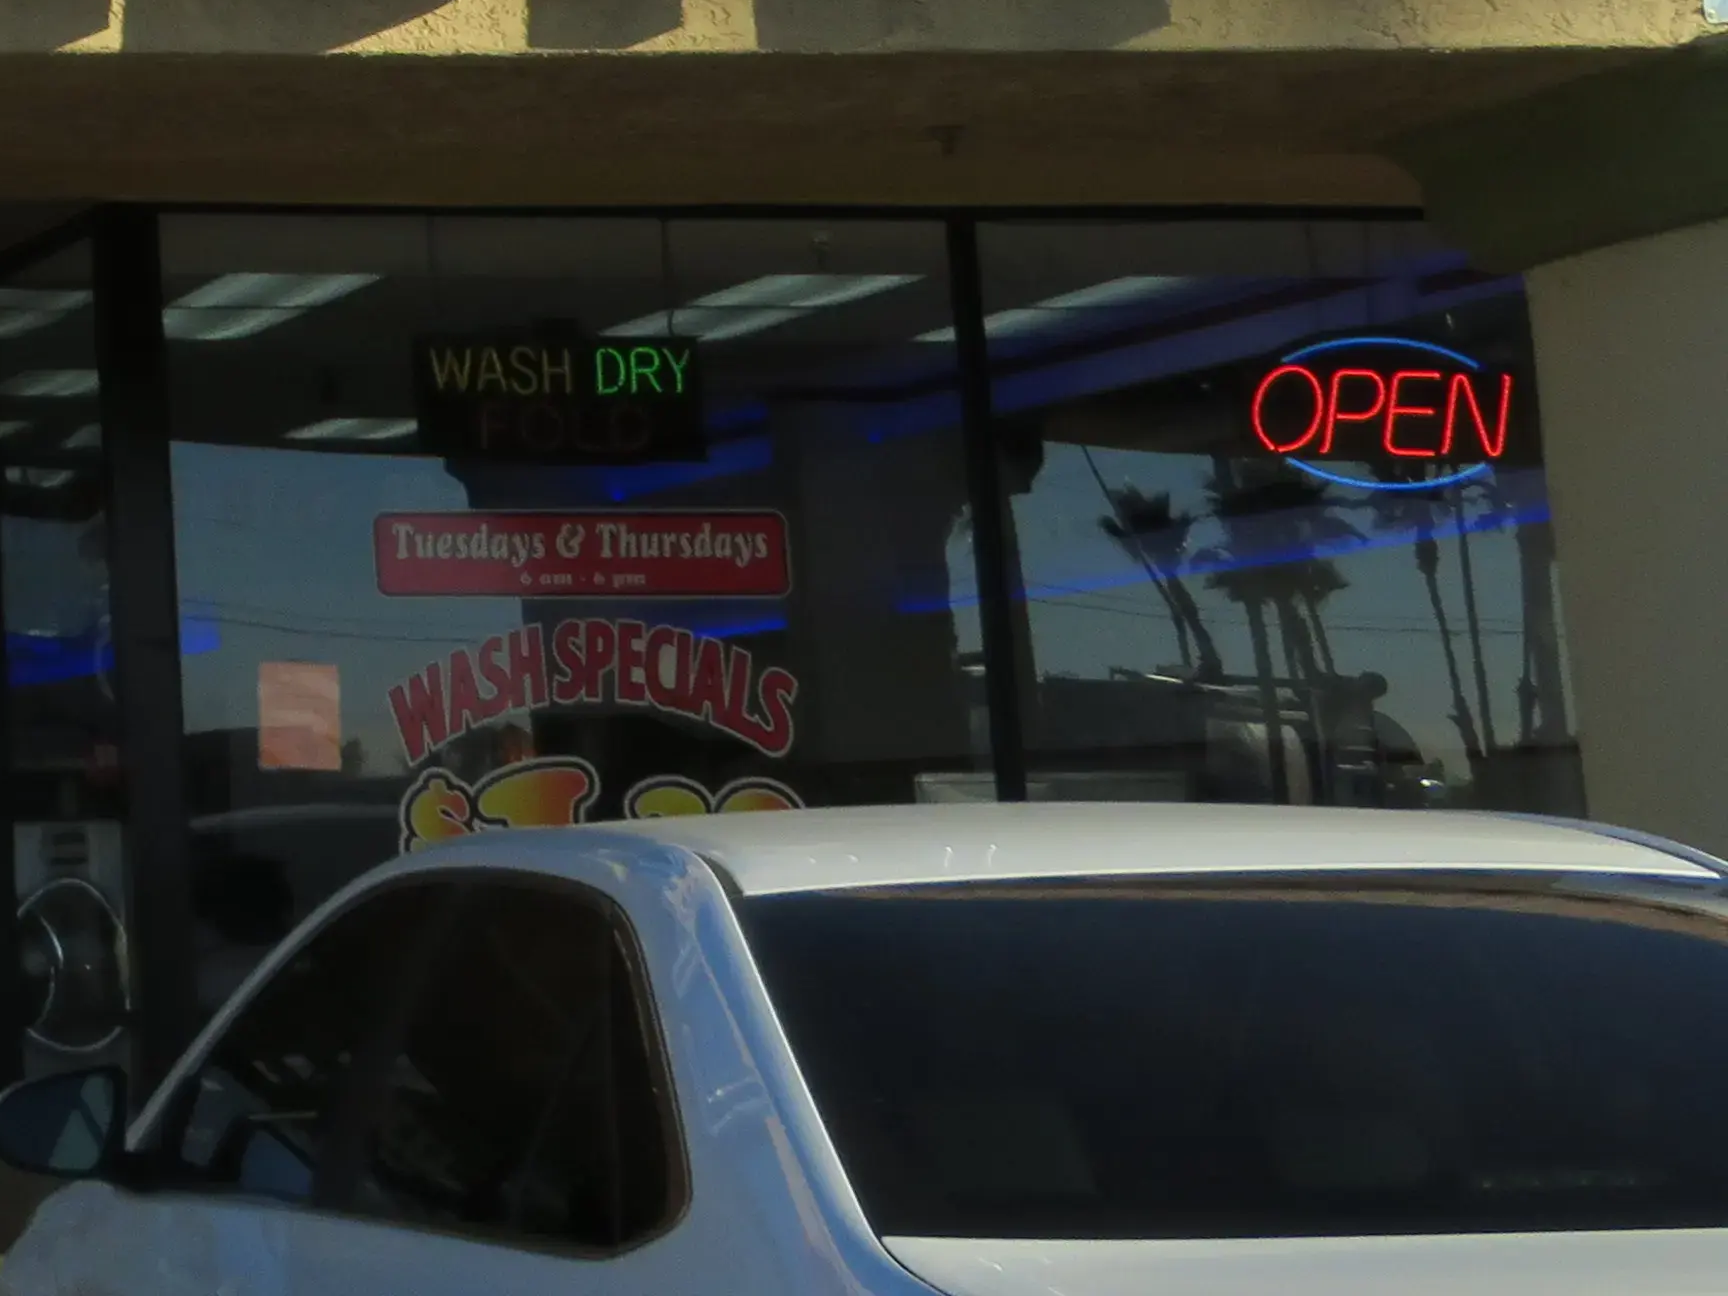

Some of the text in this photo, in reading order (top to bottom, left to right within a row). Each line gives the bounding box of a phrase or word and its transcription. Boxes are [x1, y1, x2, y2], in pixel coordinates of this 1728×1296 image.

[429, 345, 690, 395] WASH DRY
[1252, 364, 1513, 458] OPEN
[391, 521, 768, 568] Tuesdays & Thursdays
[388, 619, 799, 765] WASH SPECIALS
